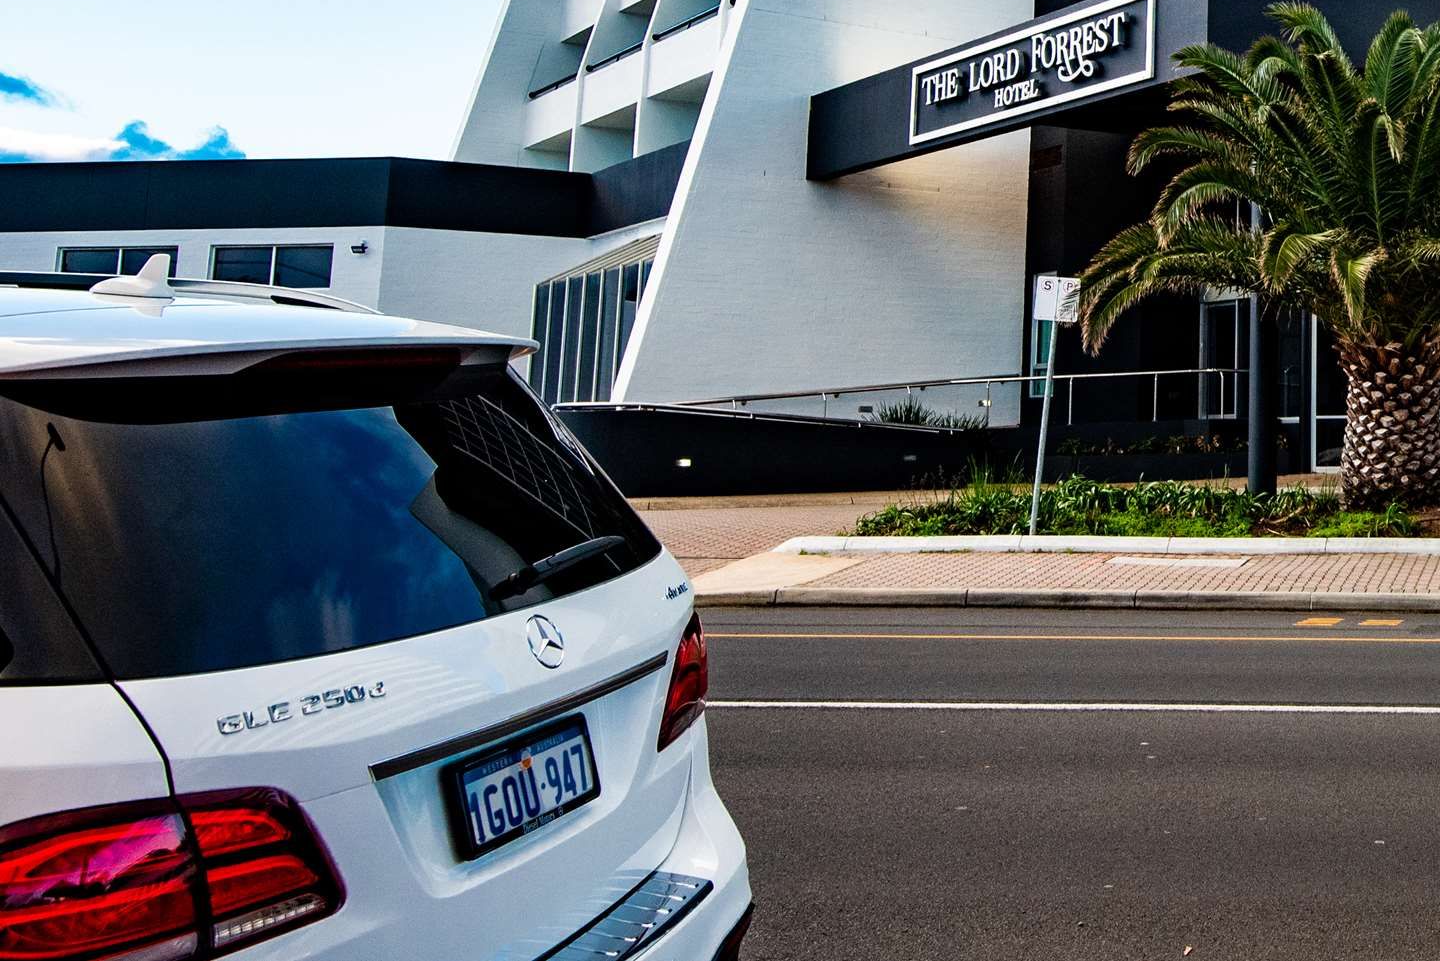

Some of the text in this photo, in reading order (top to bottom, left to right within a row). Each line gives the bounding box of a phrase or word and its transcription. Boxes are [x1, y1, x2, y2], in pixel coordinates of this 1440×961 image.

[922, 11, 1127, 106] THE LORD FORREST
[993, 79, 1039, 109] HOTEL
[1044, 281, 1052, 290] S
[217, 702, 293, 735] GLE
